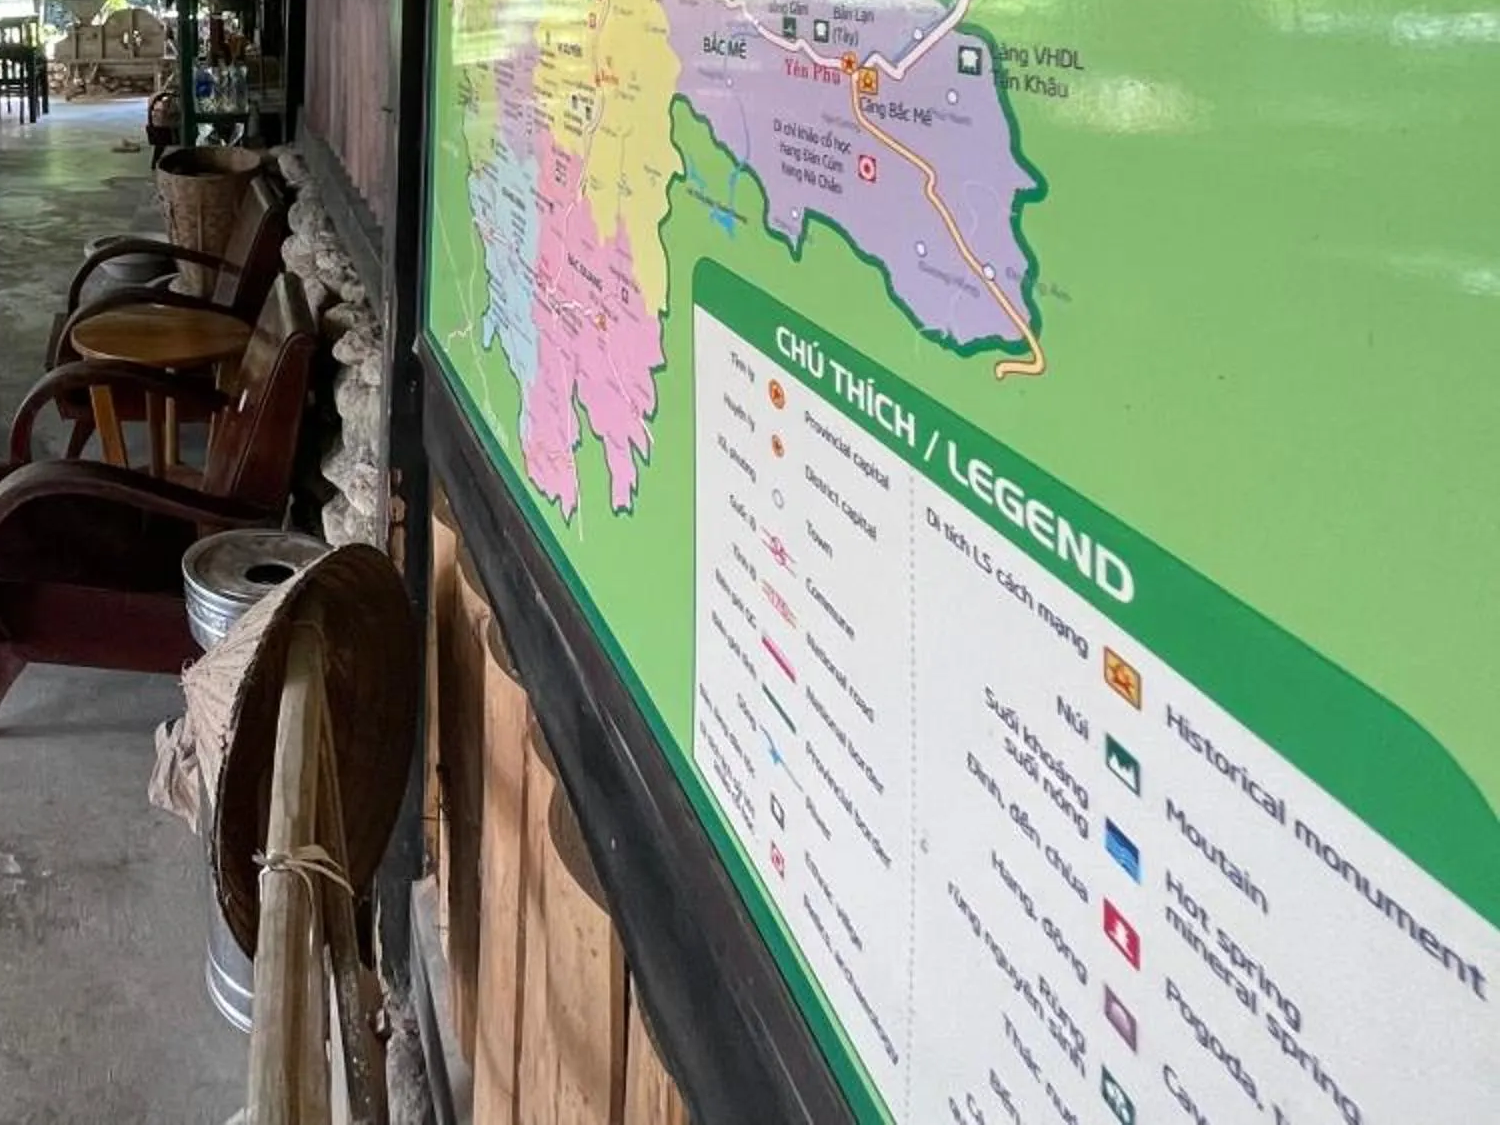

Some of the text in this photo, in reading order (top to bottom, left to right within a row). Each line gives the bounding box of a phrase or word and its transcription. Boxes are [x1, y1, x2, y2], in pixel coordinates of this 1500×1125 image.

[1034, 45, 1085, 71] VHDL
[776, 326, 1135, 603] CHÚ THÍCH / LEGEND
[804, 410, 890, 491] Provincial capital
[804, 464, 878, 542] District capital
[805, 518, 833, 559] Town
[943, 520, 971, 558] tích
[973, 545, 993, 575] LS
[996, 567, 1034, 611] cách
[1037, 602, 1089, 660] mạng
[984, 685, 1089, 812] Suối khoáng
[1056, 694, 1089, 742] Núi
[1004, 736, 1089, 841] suối nóng
[1044, 843, 1089, 905] chùa
[1165, 703, 1489, 1003] Historical monument
[1165, 798, 1269, 916] Moutain
[1165, 871, 1302, 1033] Hot spring
[1165, 904, 1363, 1125] mineral spring
